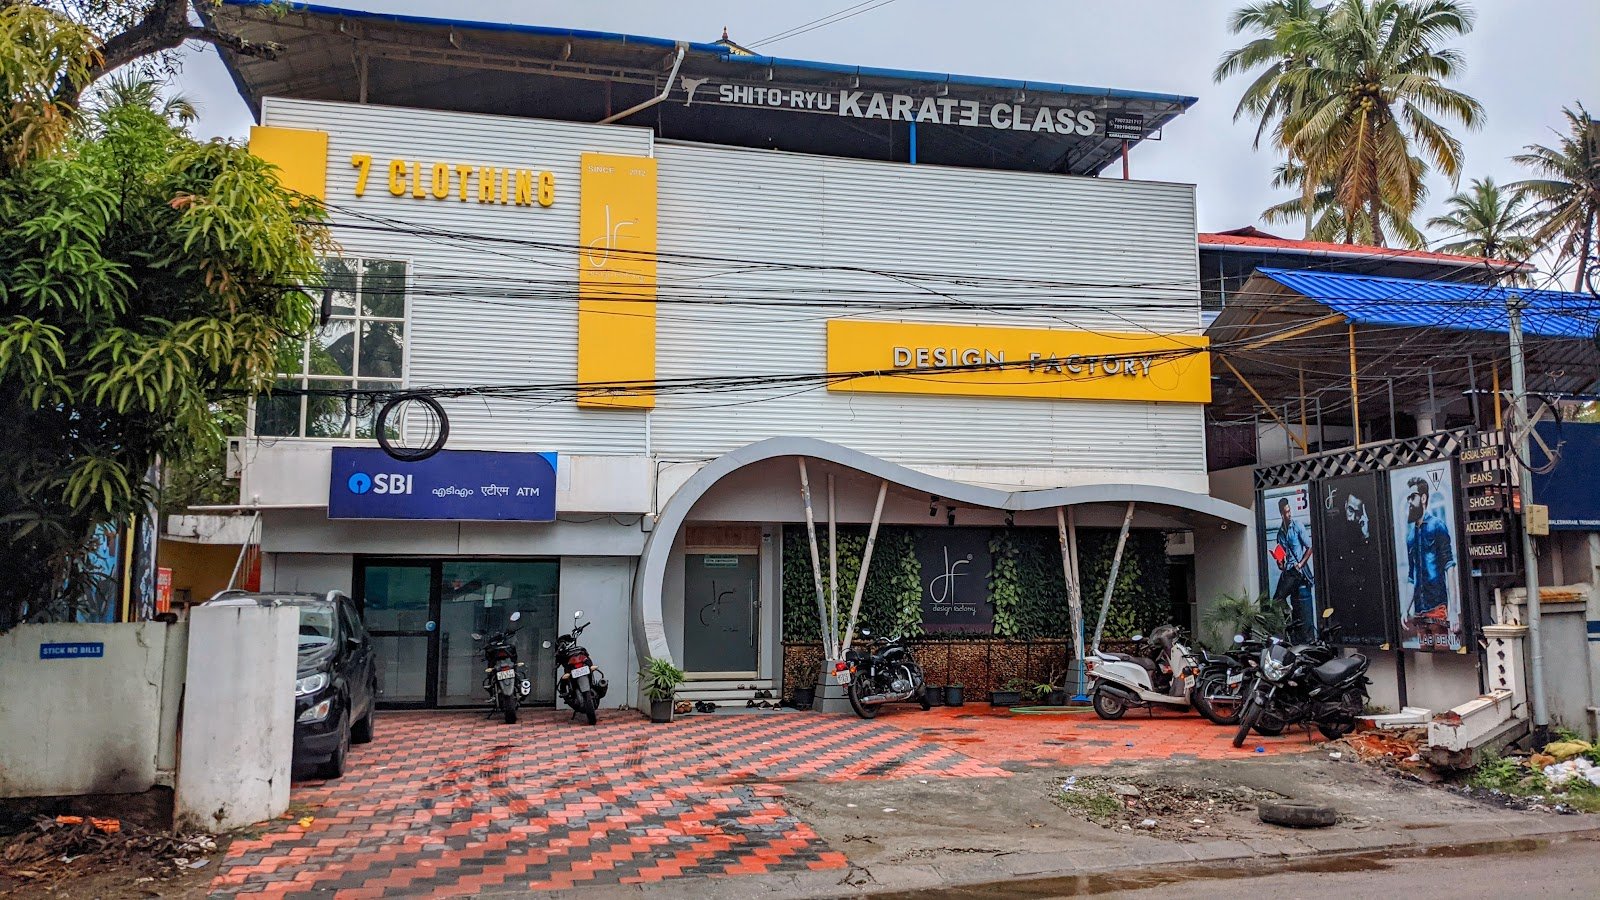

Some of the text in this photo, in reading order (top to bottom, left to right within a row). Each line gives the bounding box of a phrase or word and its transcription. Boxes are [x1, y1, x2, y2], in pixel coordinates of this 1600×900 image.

[720, 84, 1096, 136] SHITO-RYU KARATE CLASS
[588, 165, 615, 174] SINCE
[351, 154, 555, 207] 7 CLOTHING
[893, 347, 1154, 377] DESIGN FACTORY
[1460, 450, 1480, 461] CASUAL
[373, 473, 413, 495] SBI
[1469, 472, 1493, 484] JEANS
[481, 484, 510, 497] एटीएम
[516, 487, 540, 497] ATM
[1470, 496, 1495, 508] SHOES
[1466, 521, 1503, 533] ACCESSORIES
[1469, 545, 1503, 556] WHOLESALE
[933, 603, 952, 616] design
[43, 647, 65, 655] STICK
[80, 646, 101, 654] BILLS
